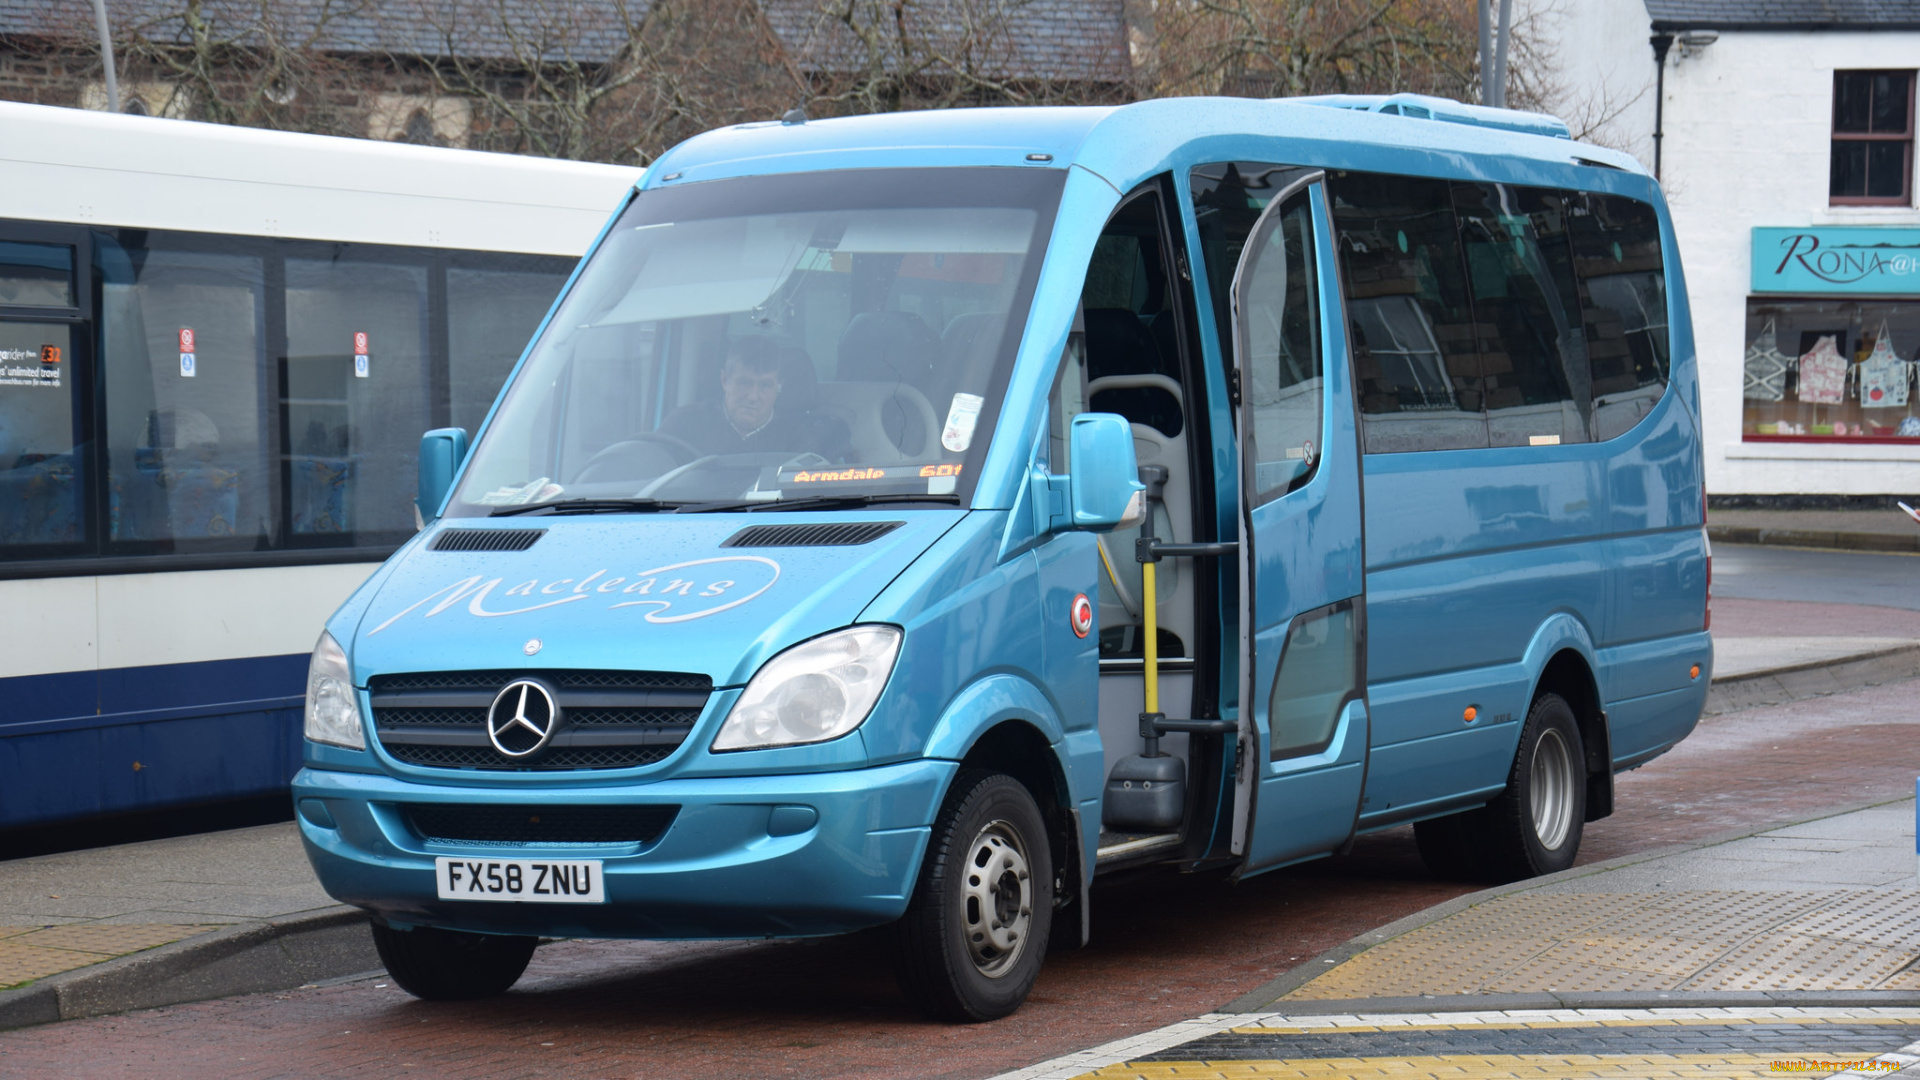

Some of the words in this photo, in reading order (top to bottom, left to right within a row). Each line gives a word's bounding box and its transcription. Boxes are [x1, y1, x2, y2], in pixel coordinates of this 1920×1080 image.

[8, 366, 39, 378] unlimited
[41, 367, 60, 378] travel
[794, 467, 885, 483] Armdale
[367, 566, 738, 634] Macleans
[448, 861, 523, 894] FX58
[531, 864, 591, 895] ZNU
